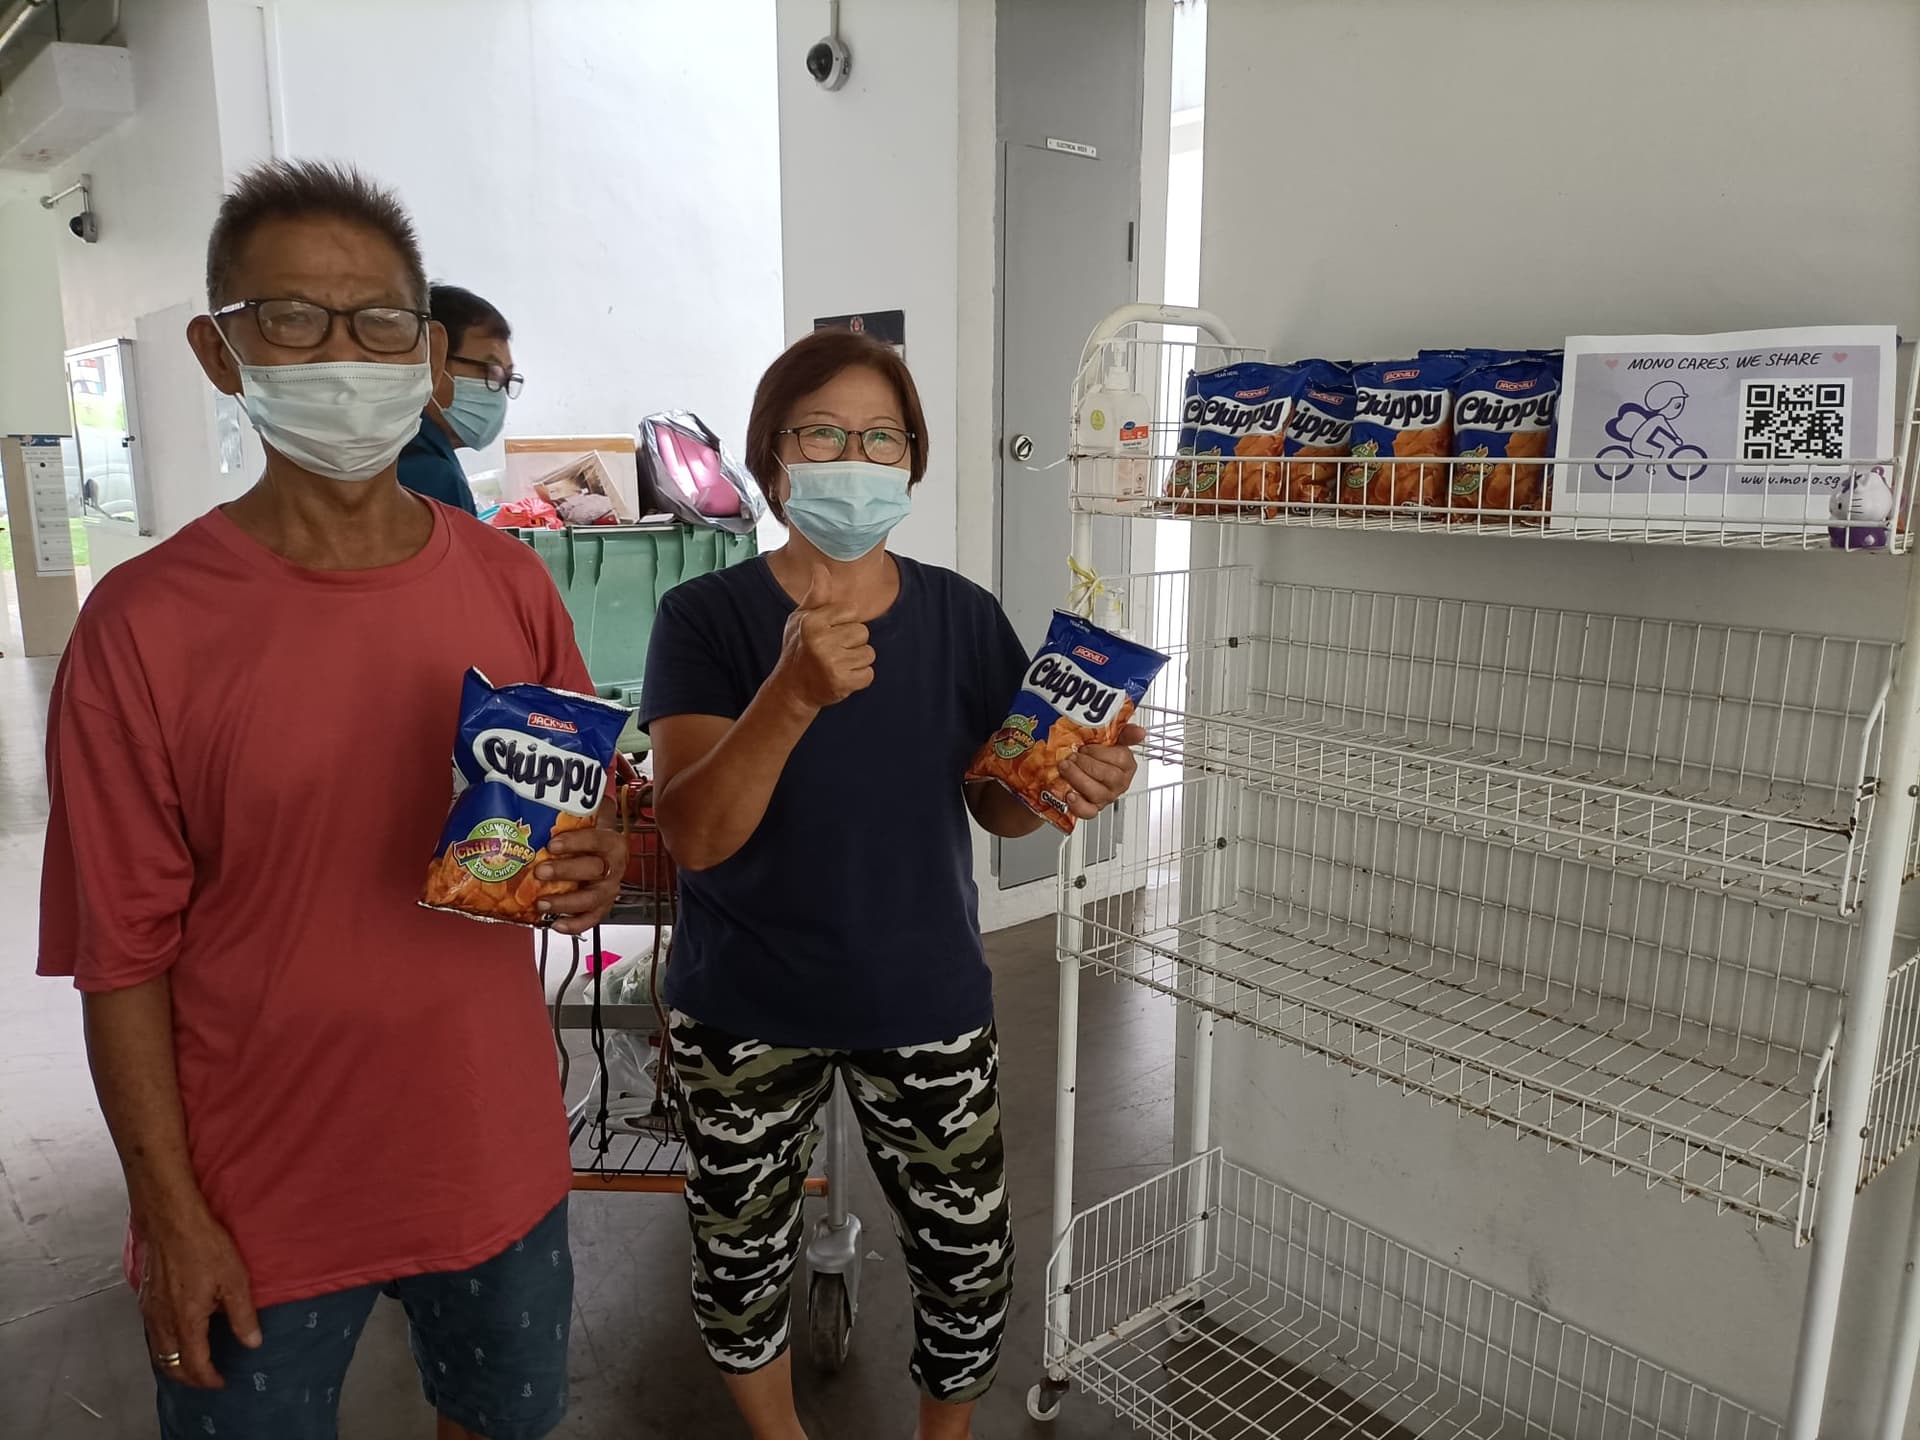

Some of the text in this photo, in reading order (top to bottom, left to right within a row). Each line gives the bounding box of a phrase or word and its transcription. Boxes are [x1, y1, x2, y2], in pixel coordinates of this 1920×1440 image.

[1627, 357, 1675, 370] MONO
[1736, 354, 1762, 368] WE
[1765, 352, 1823, 366] SHARE
[1201, 400, 1284, 434] Chippy
[1289, 408, 1351, 444] ippy
[1356, 390, 1442, 426] Chippy
[1456, 394, 1554, 430] Chippy
[1029, 657, 1118, 723] Chippy
[482, 736, 602, 808] Chippy
[479, 823, 519, 838] FLAVORED
[494, 863, 516, 877] CHIPS
